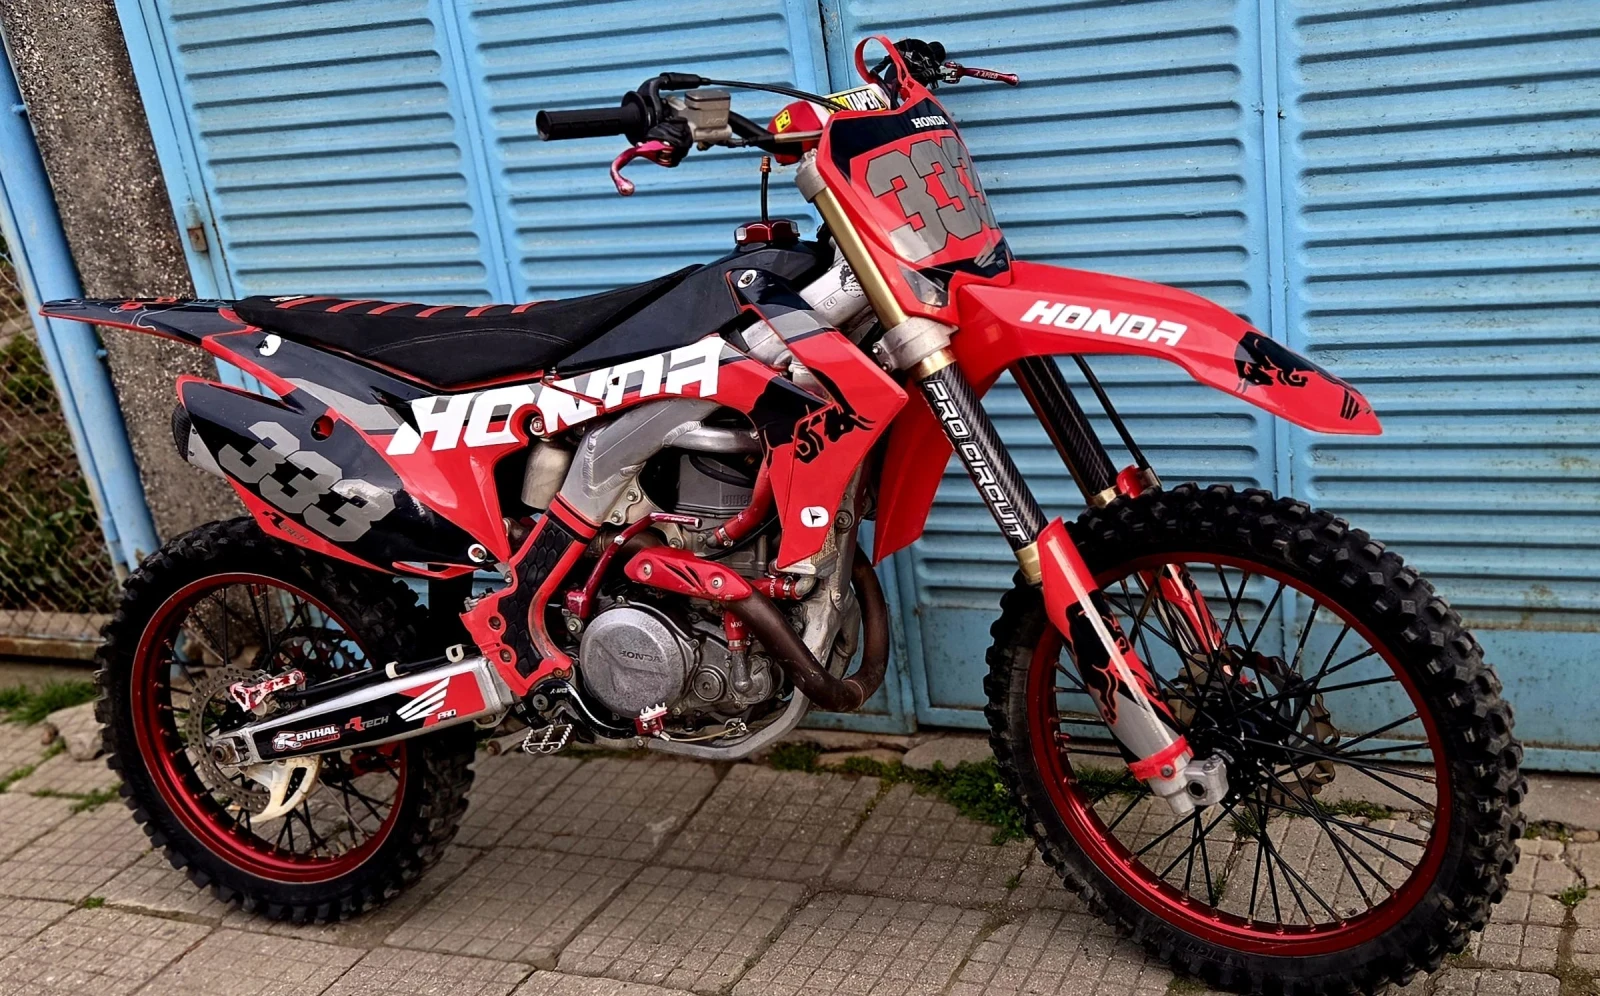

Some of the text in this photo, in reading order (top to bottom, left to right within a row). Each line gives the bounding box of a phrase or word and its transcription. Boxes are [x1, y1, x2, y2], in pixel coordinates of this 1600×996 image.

[911, 115, 949, 129] HONDA
[1020, 300, 1188, 347] HONDA
[218, 421, 396, 542] 333
[924, 380, 1030, 543] PRO CIRCUIT
[437, 709, 457, 721] PRO
